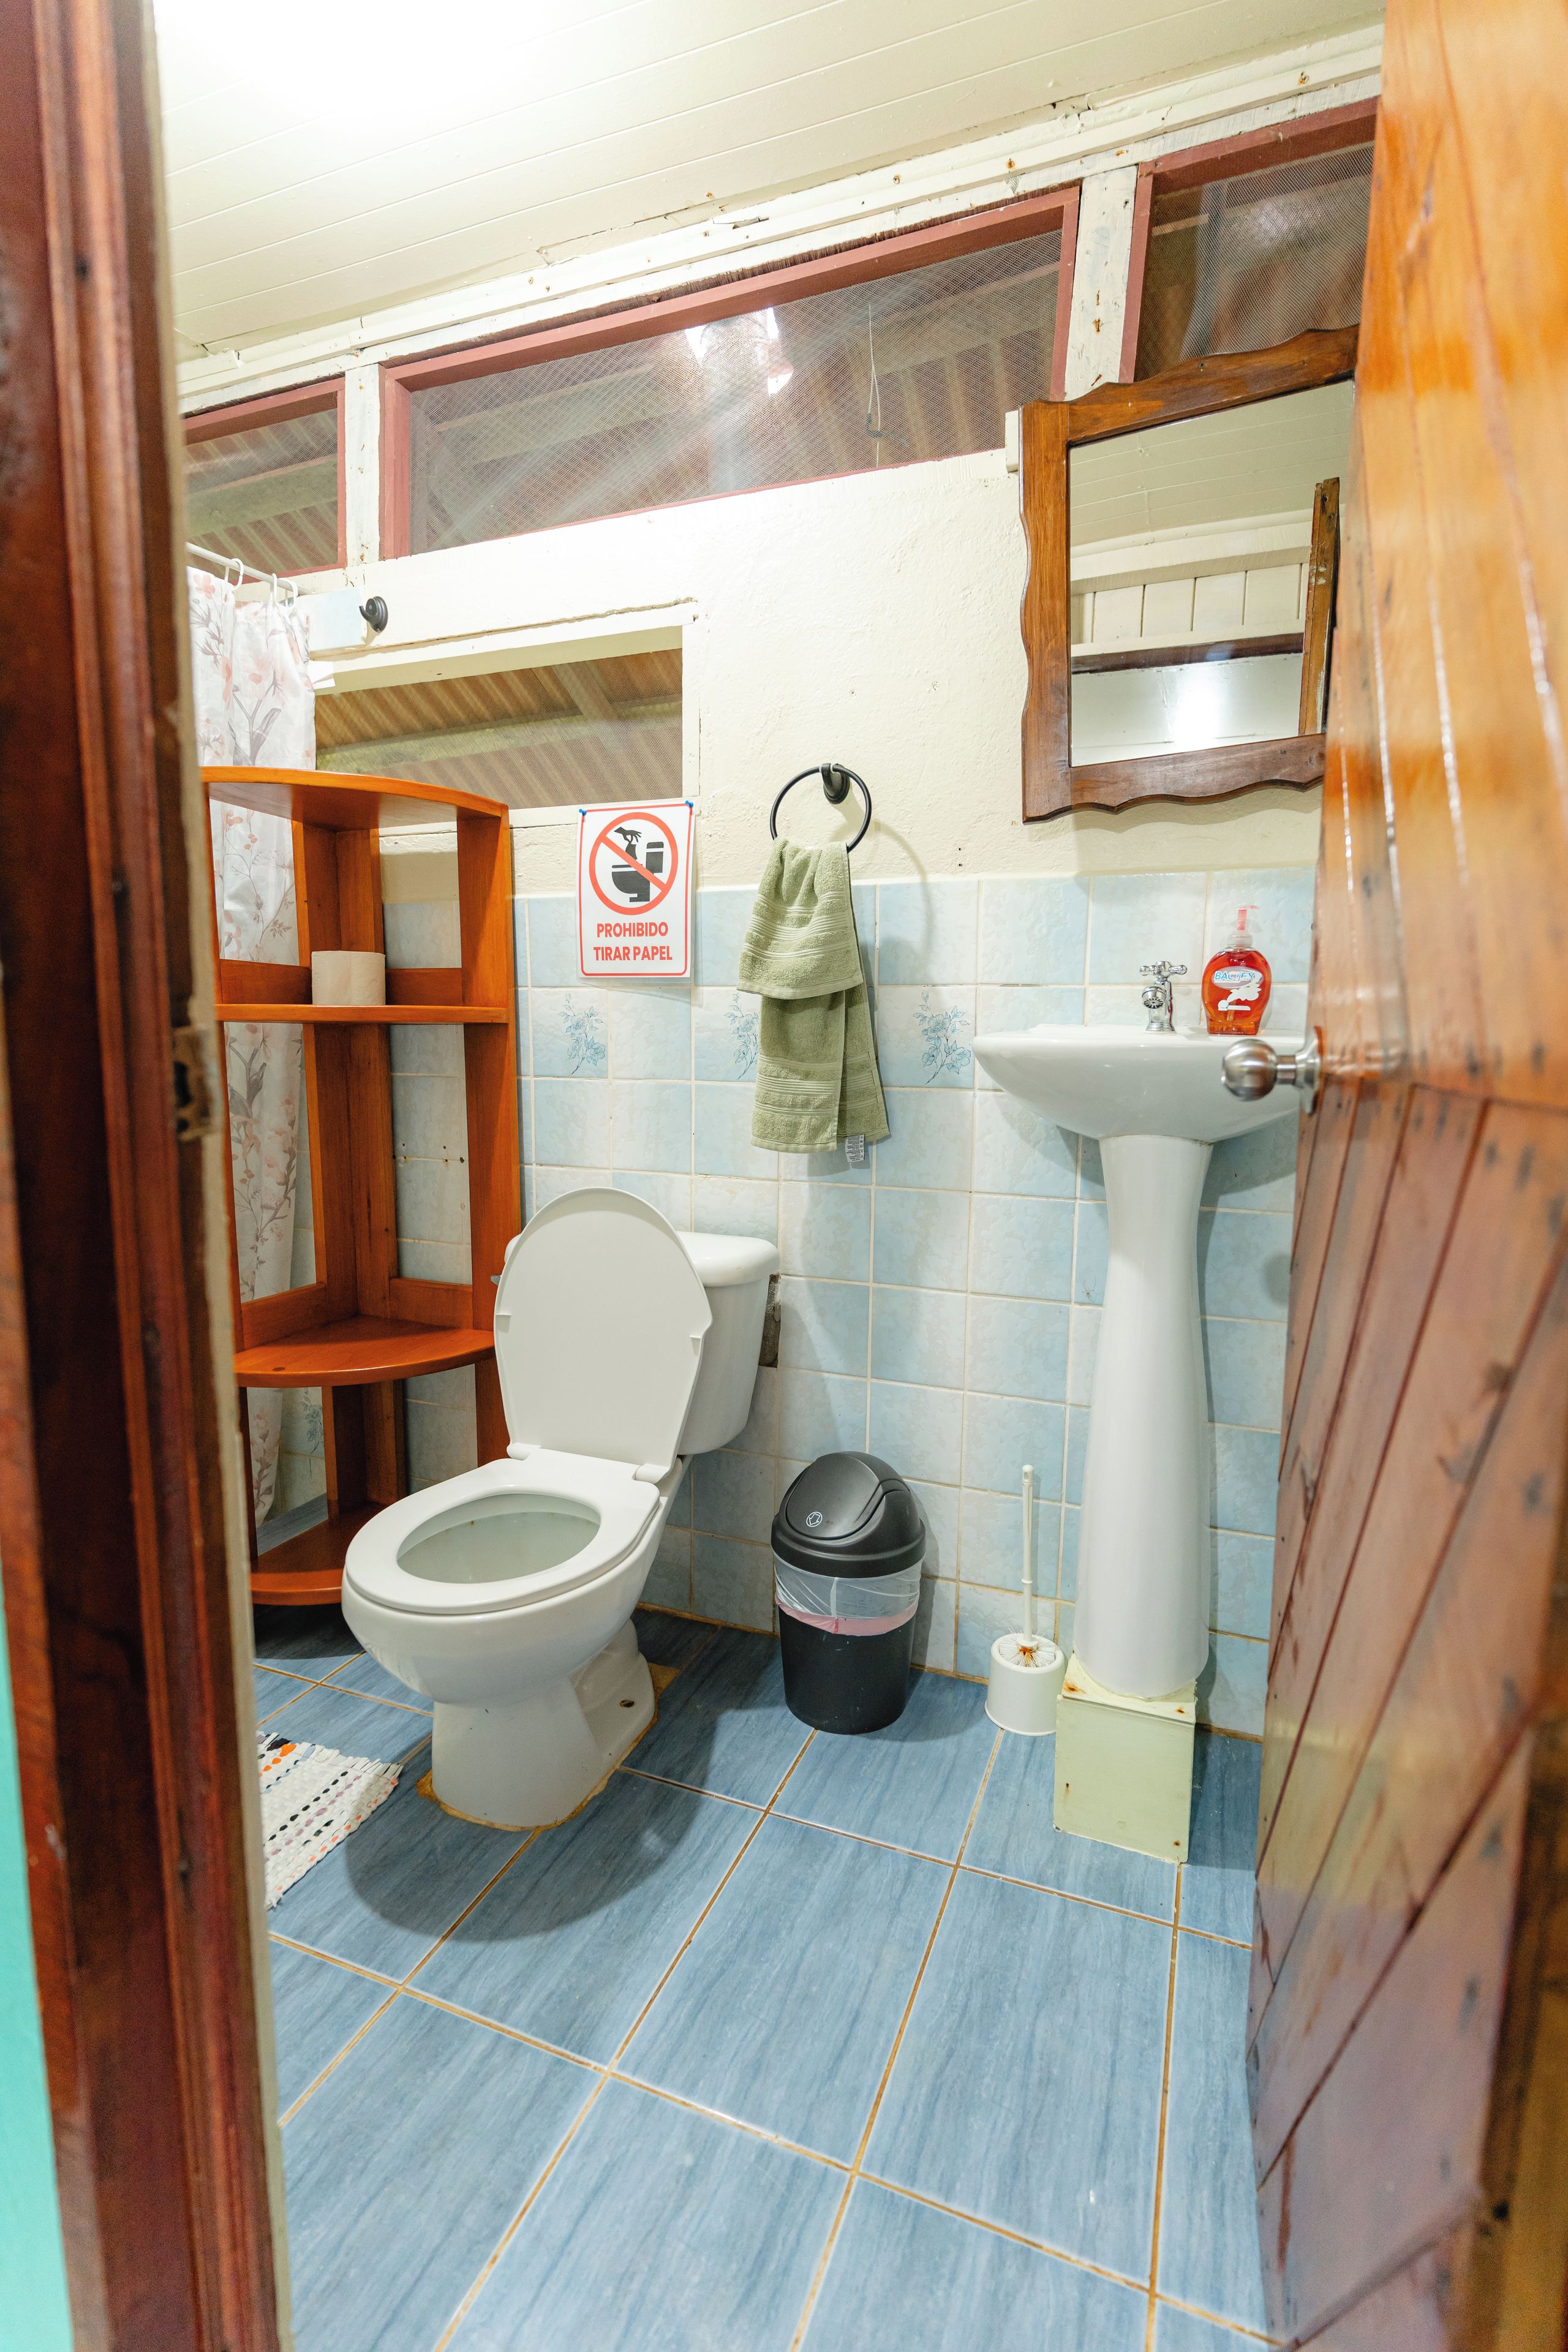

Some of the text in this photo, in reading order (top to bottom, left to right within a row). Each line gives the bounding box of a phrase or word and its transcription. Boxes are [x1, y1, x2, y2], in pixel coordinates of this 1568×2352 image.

[597, 922, 668, 937] PROHIBIDO
[594, 946, 673, 961] TIRAR PAPEL
